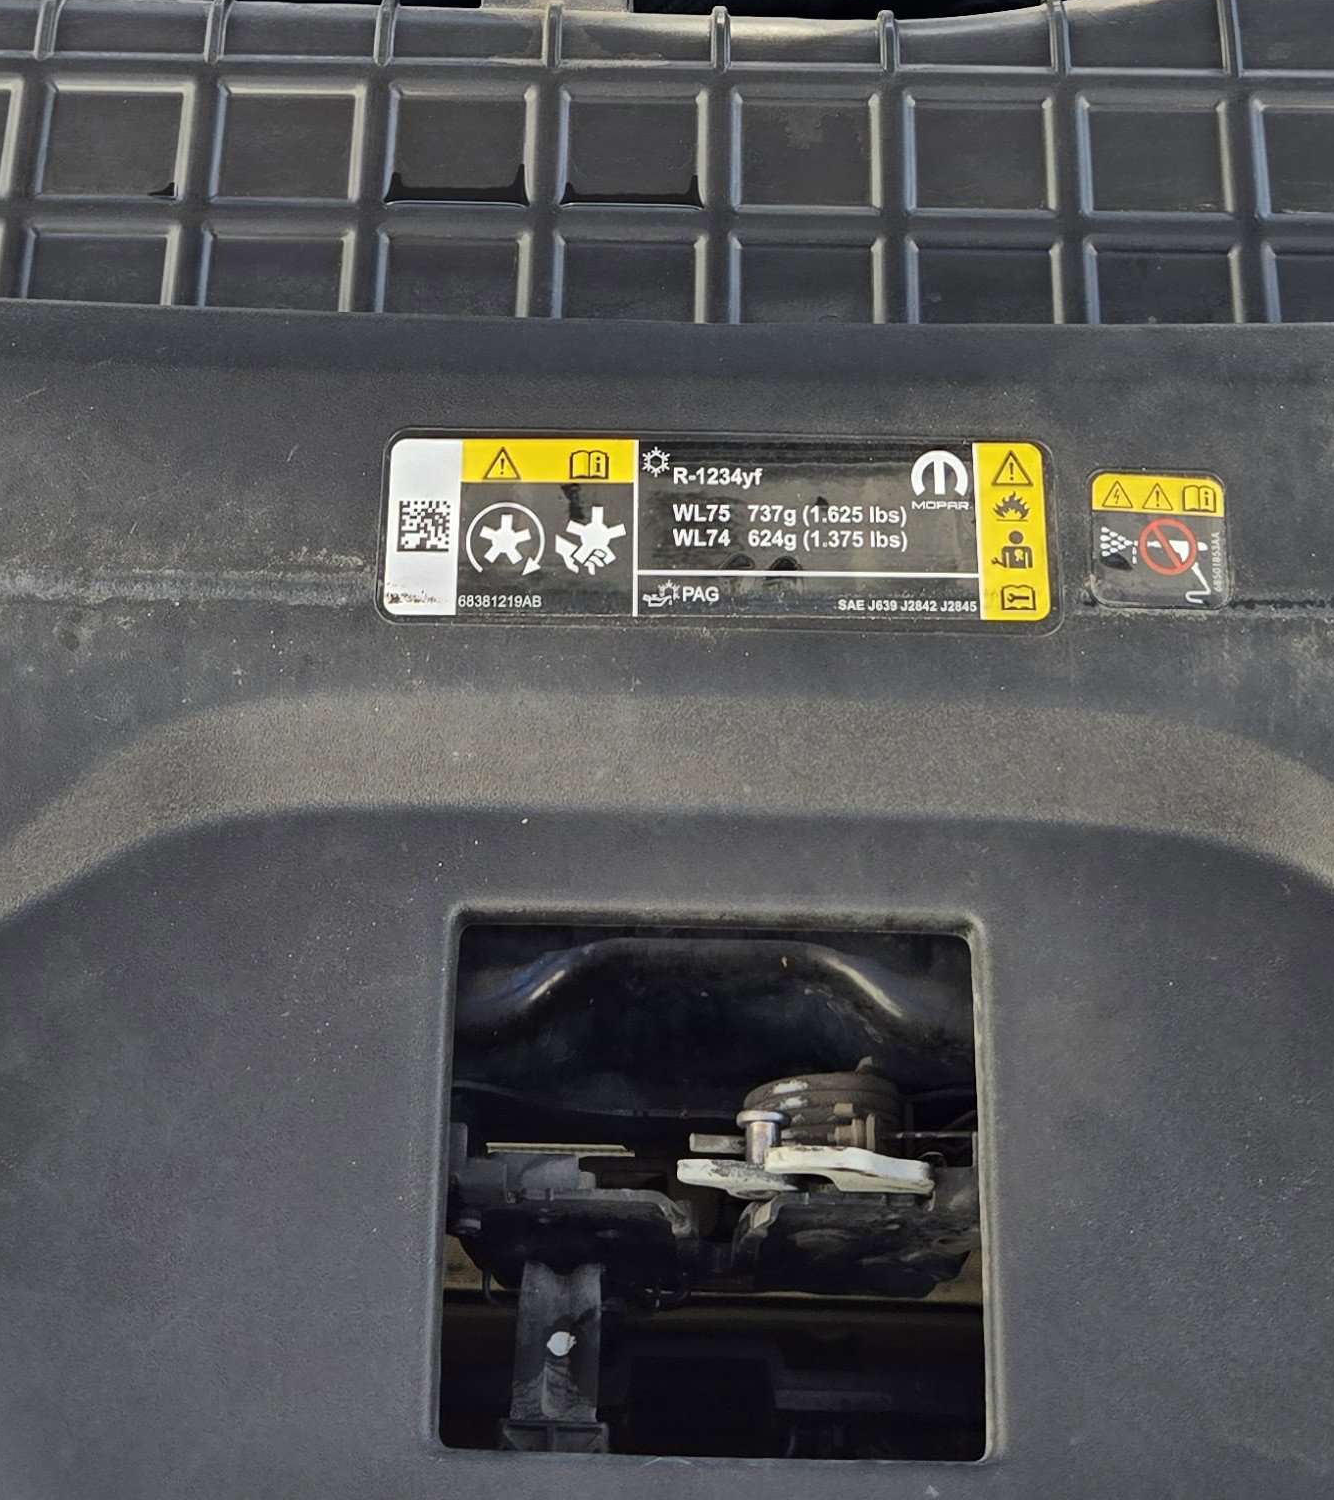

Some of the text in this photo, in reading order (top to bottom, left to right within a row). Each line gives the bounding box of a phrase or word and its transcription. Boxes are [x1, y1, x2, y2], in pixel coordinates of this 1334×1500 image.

[672, 466, 764, 490] R-1234yf
[911, 500, 970, 511] MOPAR
[672, 503, 908, 528] WL75 737g (1.625 lbs)
[672, 528, 909, 553] WL74 624g (1.375 lbs)
[458, 594, 542, 608] 68381219AB
[682, 586, 720, 603] PAG
[838, 599, 978, 613] SAE J639 J2842 J2845
